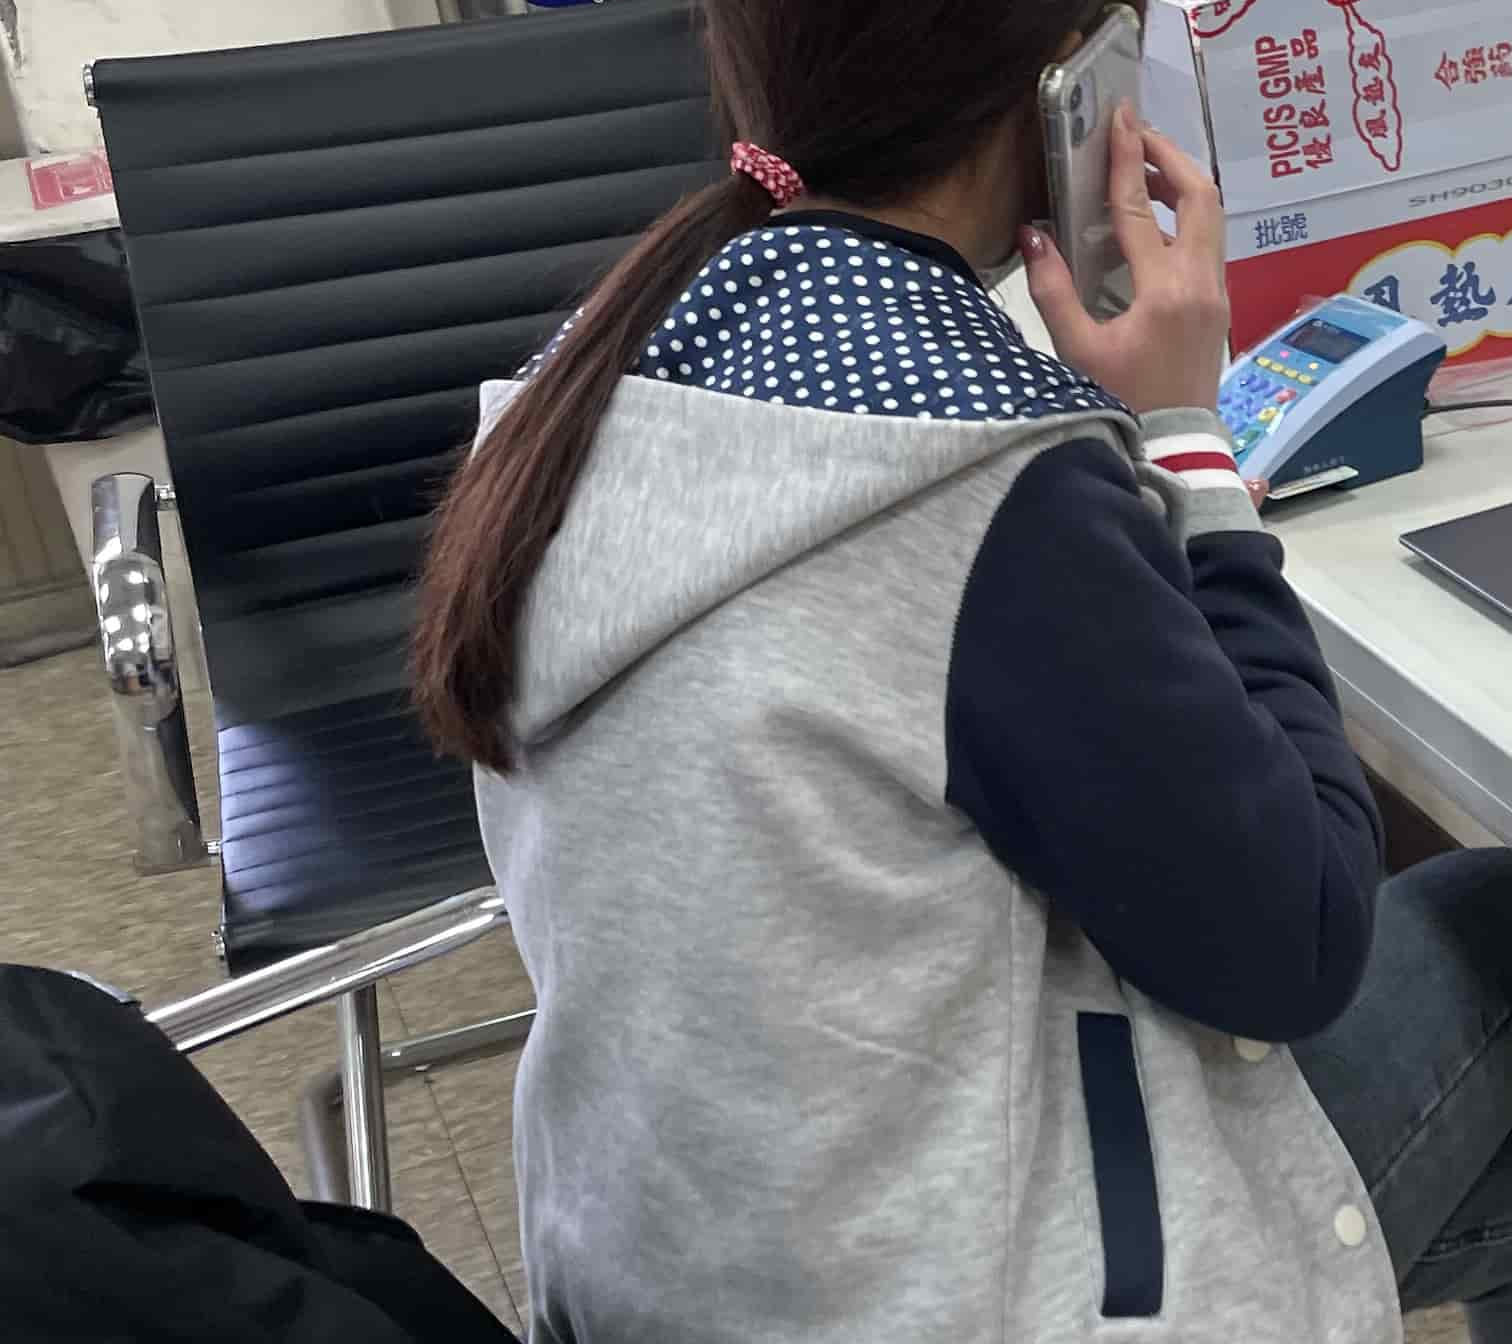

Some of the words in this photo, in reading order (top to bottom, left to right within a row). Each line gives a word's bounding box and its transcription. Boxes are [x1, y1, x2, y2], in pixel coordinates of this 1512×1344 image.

[1254, 35, 1293, 100] GMP
[1262, 102, 1304, 179] PIC/S
[1255, 212, 1309, 250] 批號
